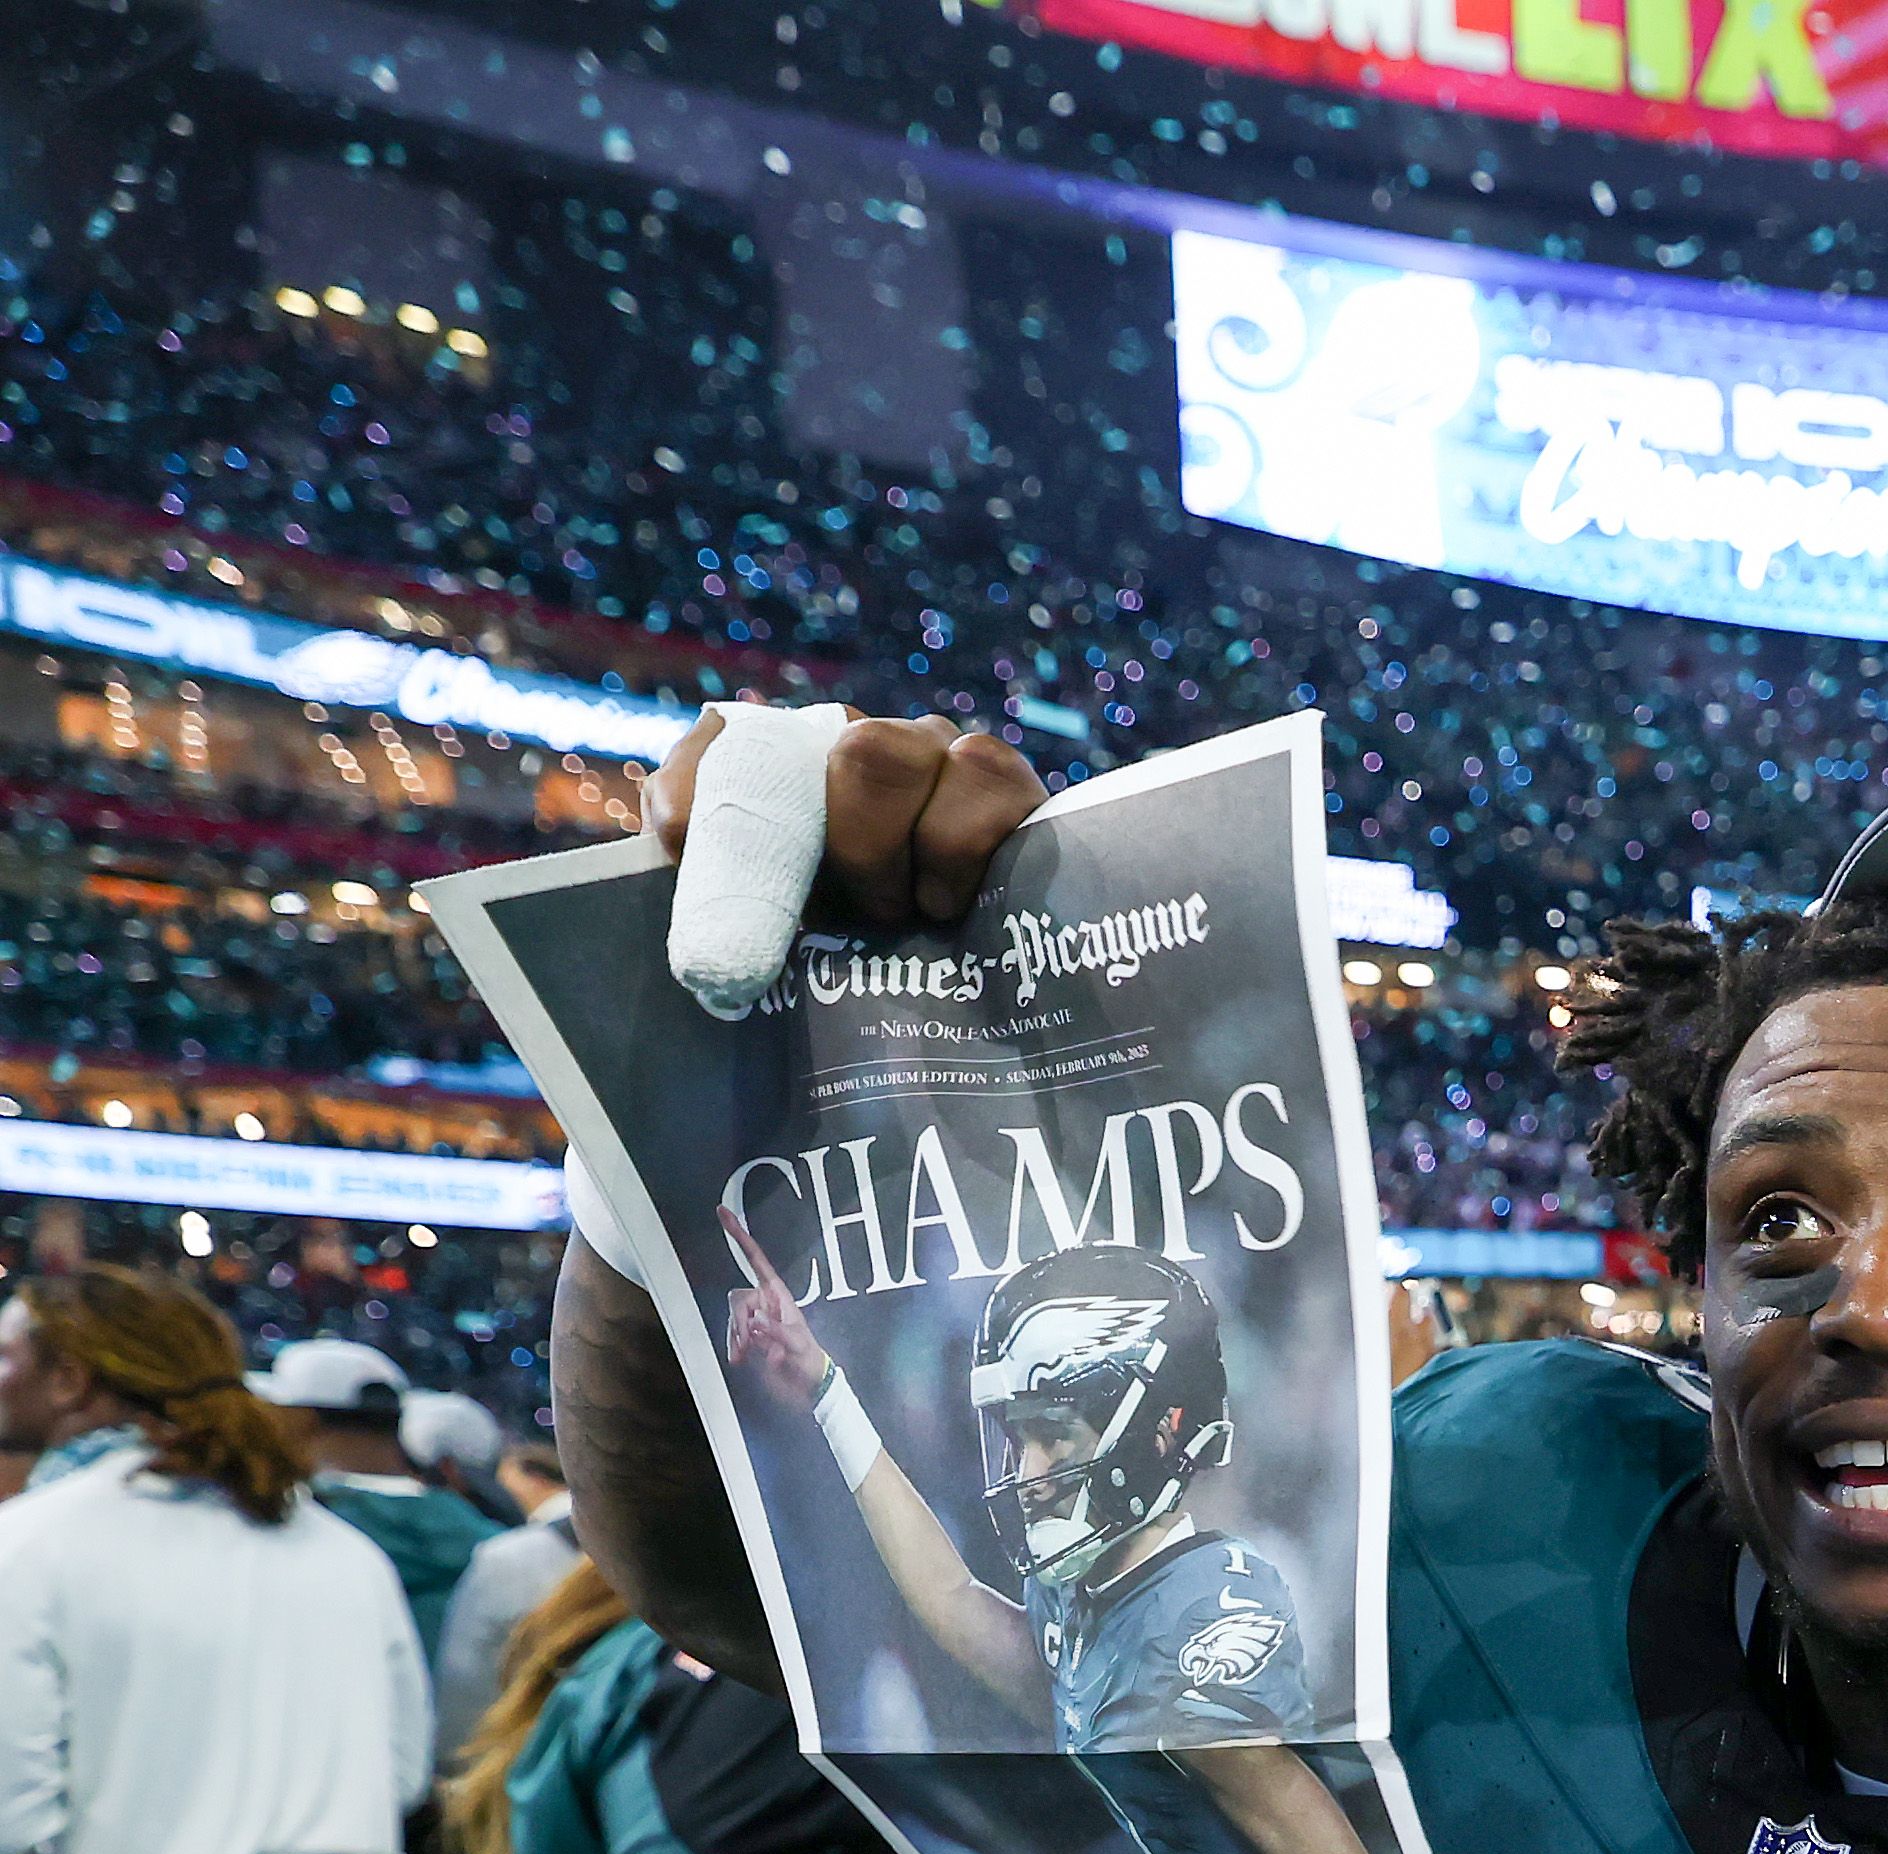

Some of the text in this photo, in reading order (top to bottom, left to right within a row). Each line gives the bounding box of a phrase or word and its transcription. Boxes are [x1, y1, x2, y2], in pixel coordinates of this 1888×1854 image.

[863, 1071, 919, 1089] STADIUM
[921, 1071, 988, 1085] EDITION
[1055, 1052, 1109, 1077] FEBRUARY
[719, 1082, 1303, 1312] CHAMPS
